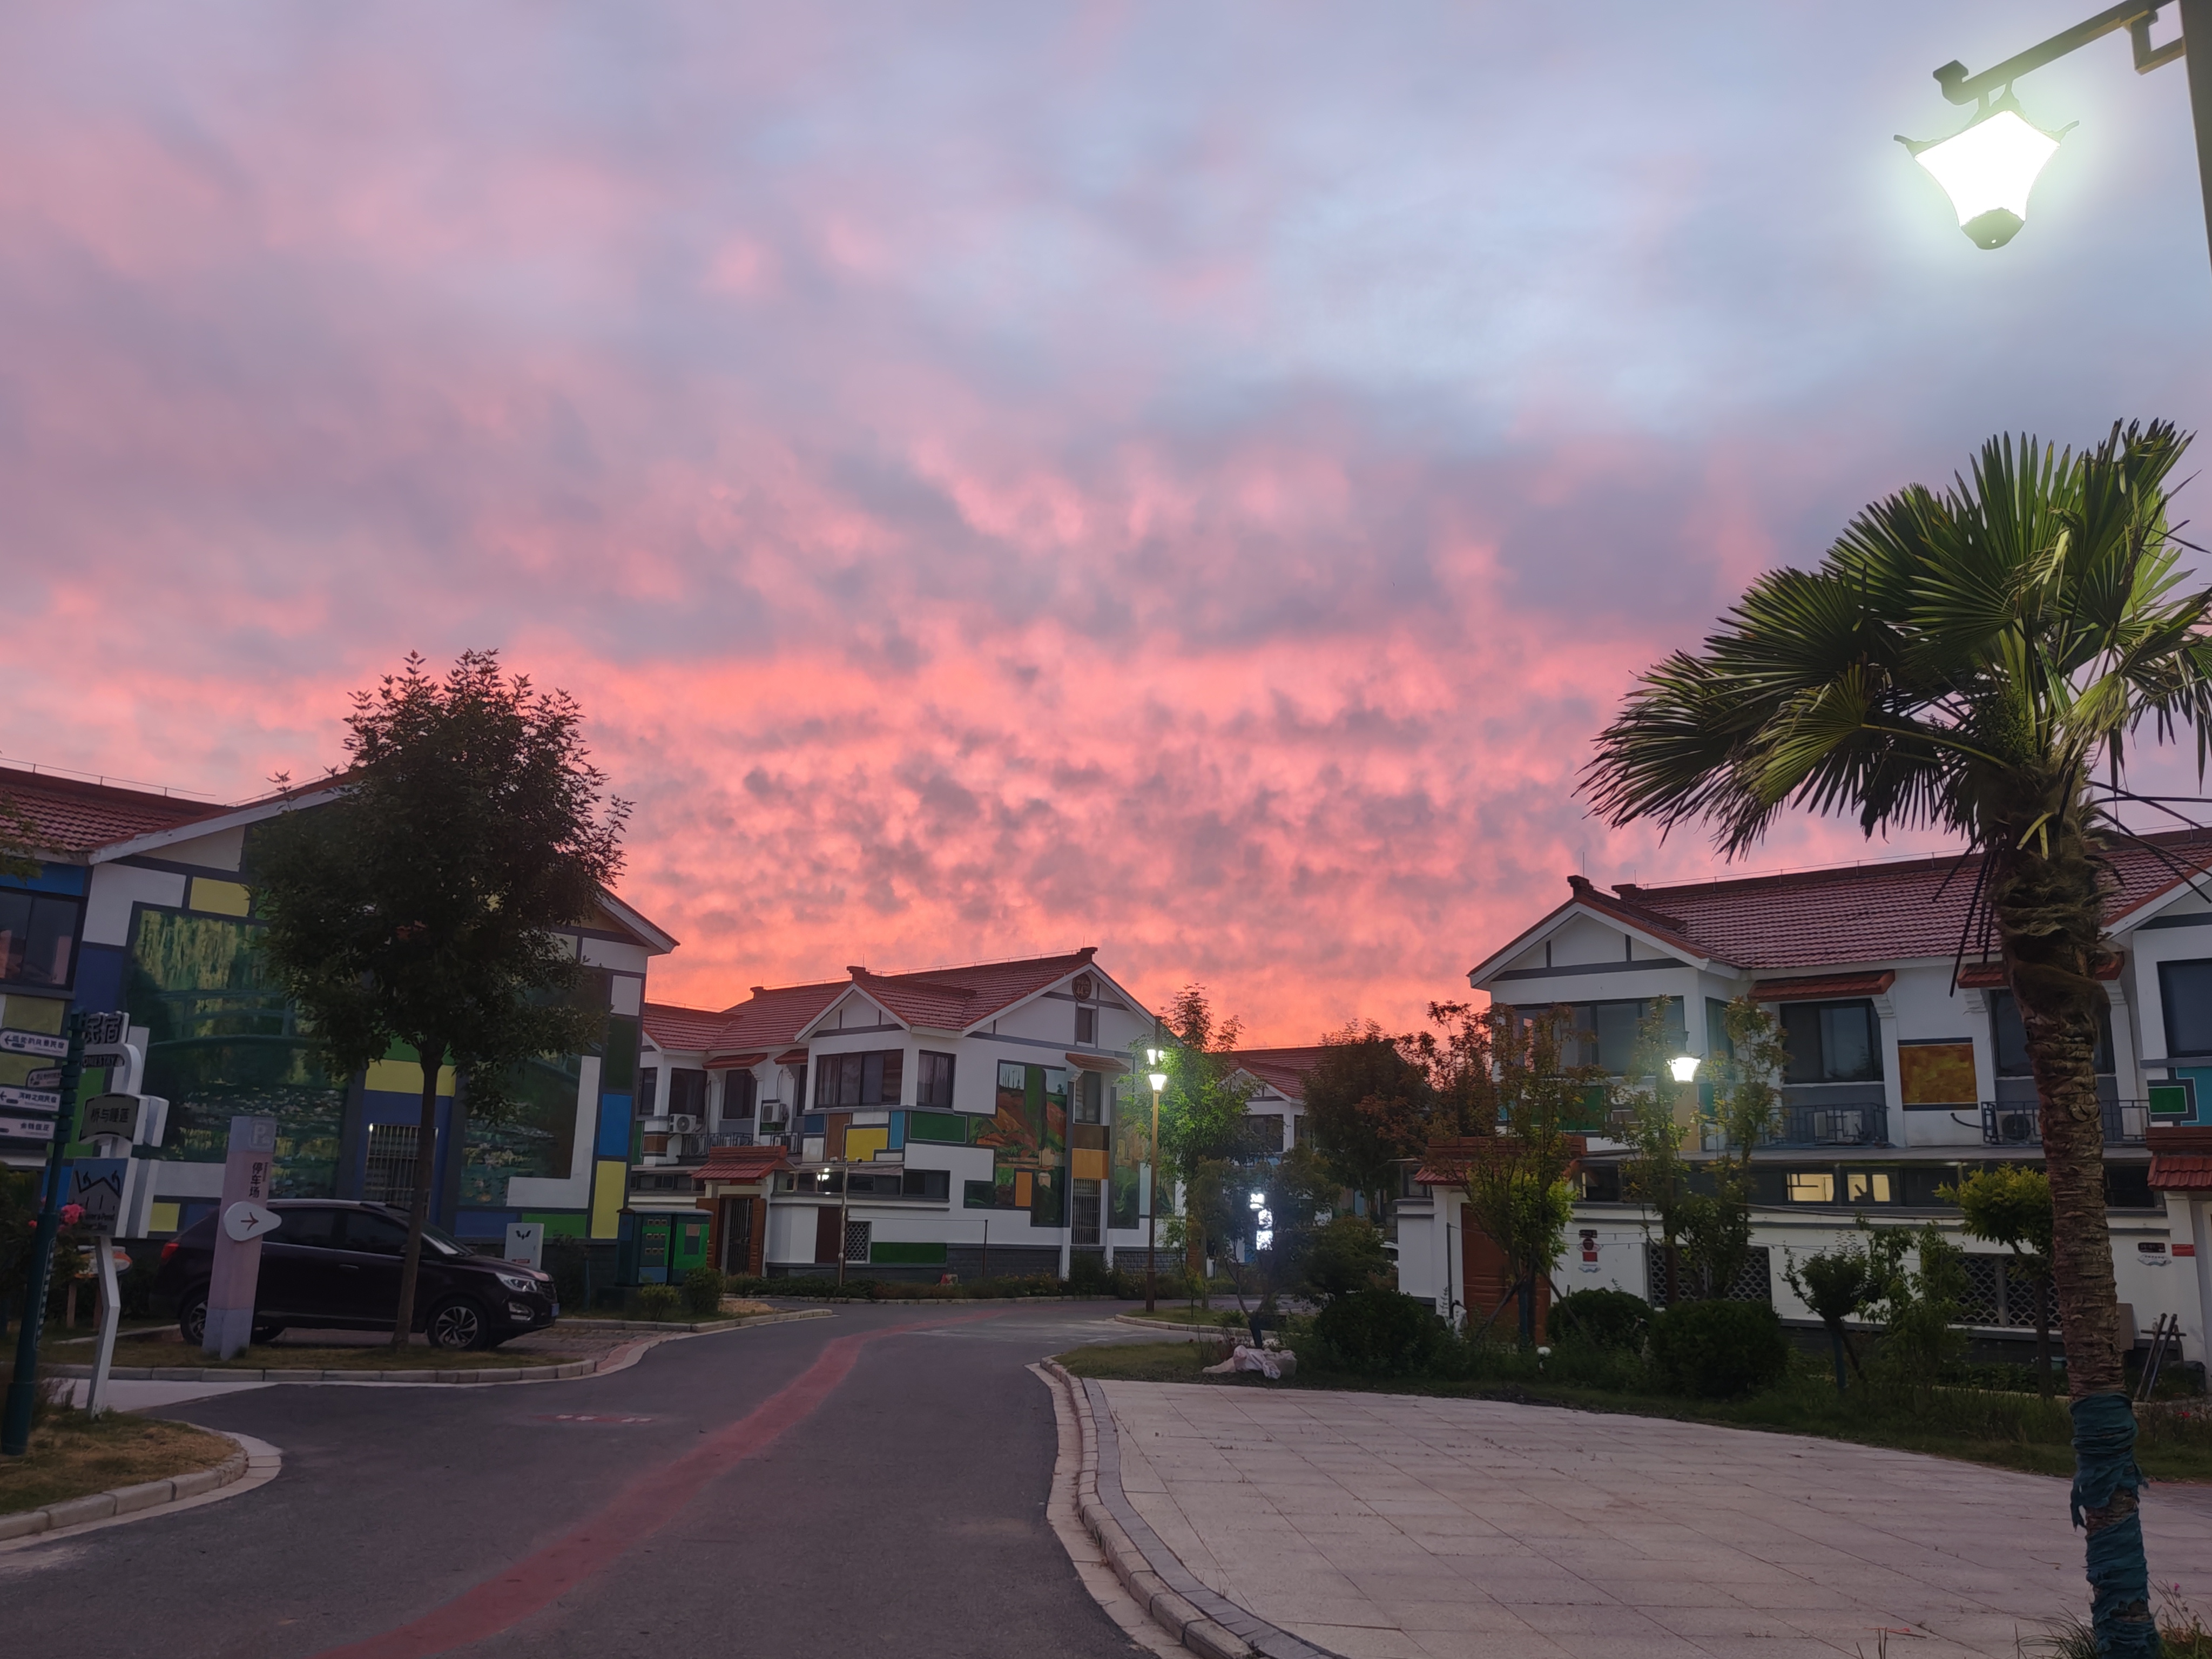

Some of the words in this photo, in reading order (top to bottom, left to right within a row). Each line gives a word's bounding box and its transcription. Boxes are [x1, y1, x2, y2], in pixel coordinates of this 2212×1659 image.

[83, 1055, 115, 1067] OMESTAY
[248, 1162, 263, 1199] 停车场
